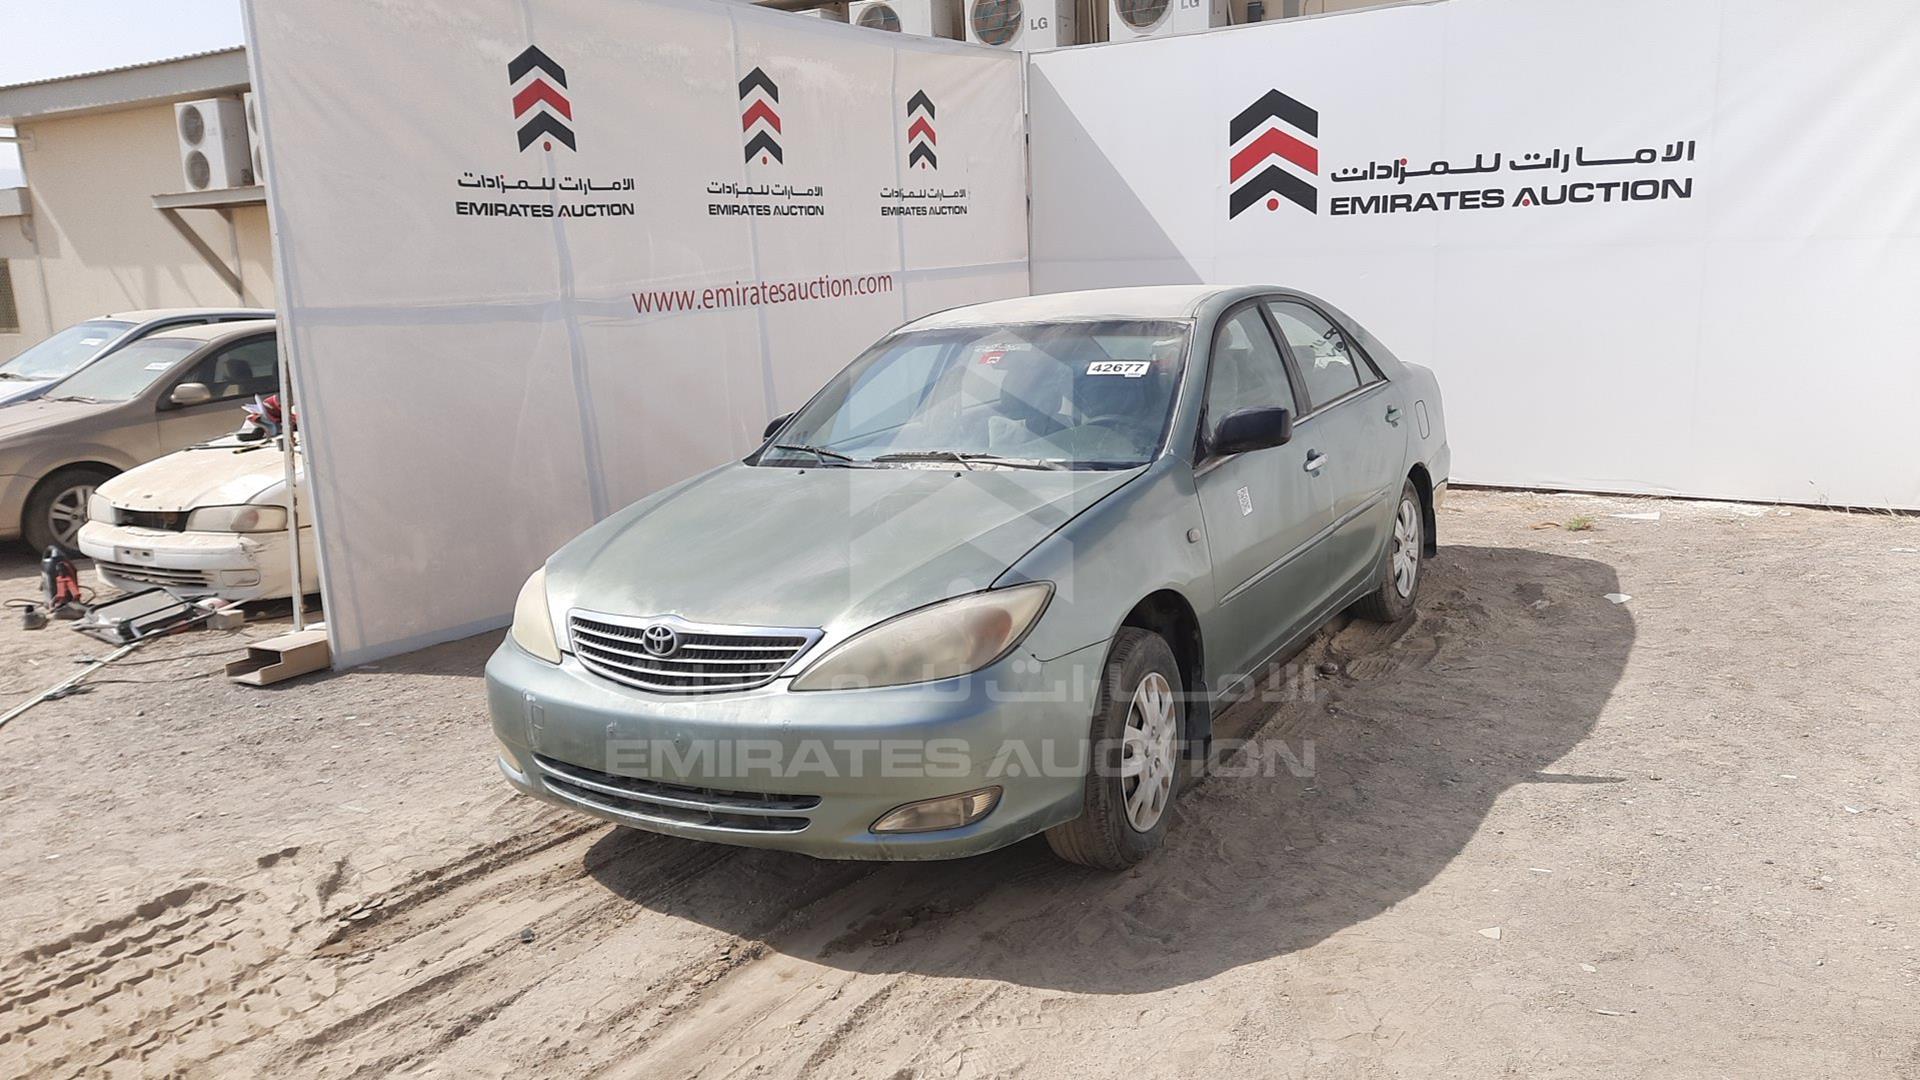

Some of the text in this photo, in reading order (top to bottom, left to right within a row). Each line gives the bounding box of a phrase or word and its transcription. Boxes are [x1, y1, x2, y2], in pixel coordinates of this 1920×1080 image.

[1029, 17, 1048, 31] LG
[1330, 140, 1696, 185] الامارات للمزادات
[457, 171, 556, 194] للمزادات
[1330, 177, 1693, 216] EMIRATES AUCTION
[455, 201, 635, 218] EMIRATES AUCTION
[708, 204, 825, 216] EMIRATES AUCTION
[880, 205, 968, 216] EMIRATES AUCTION
[631, 274, 894, 314] www.emiratesauction.com
[1091, 363, 1145, 373] 42677
